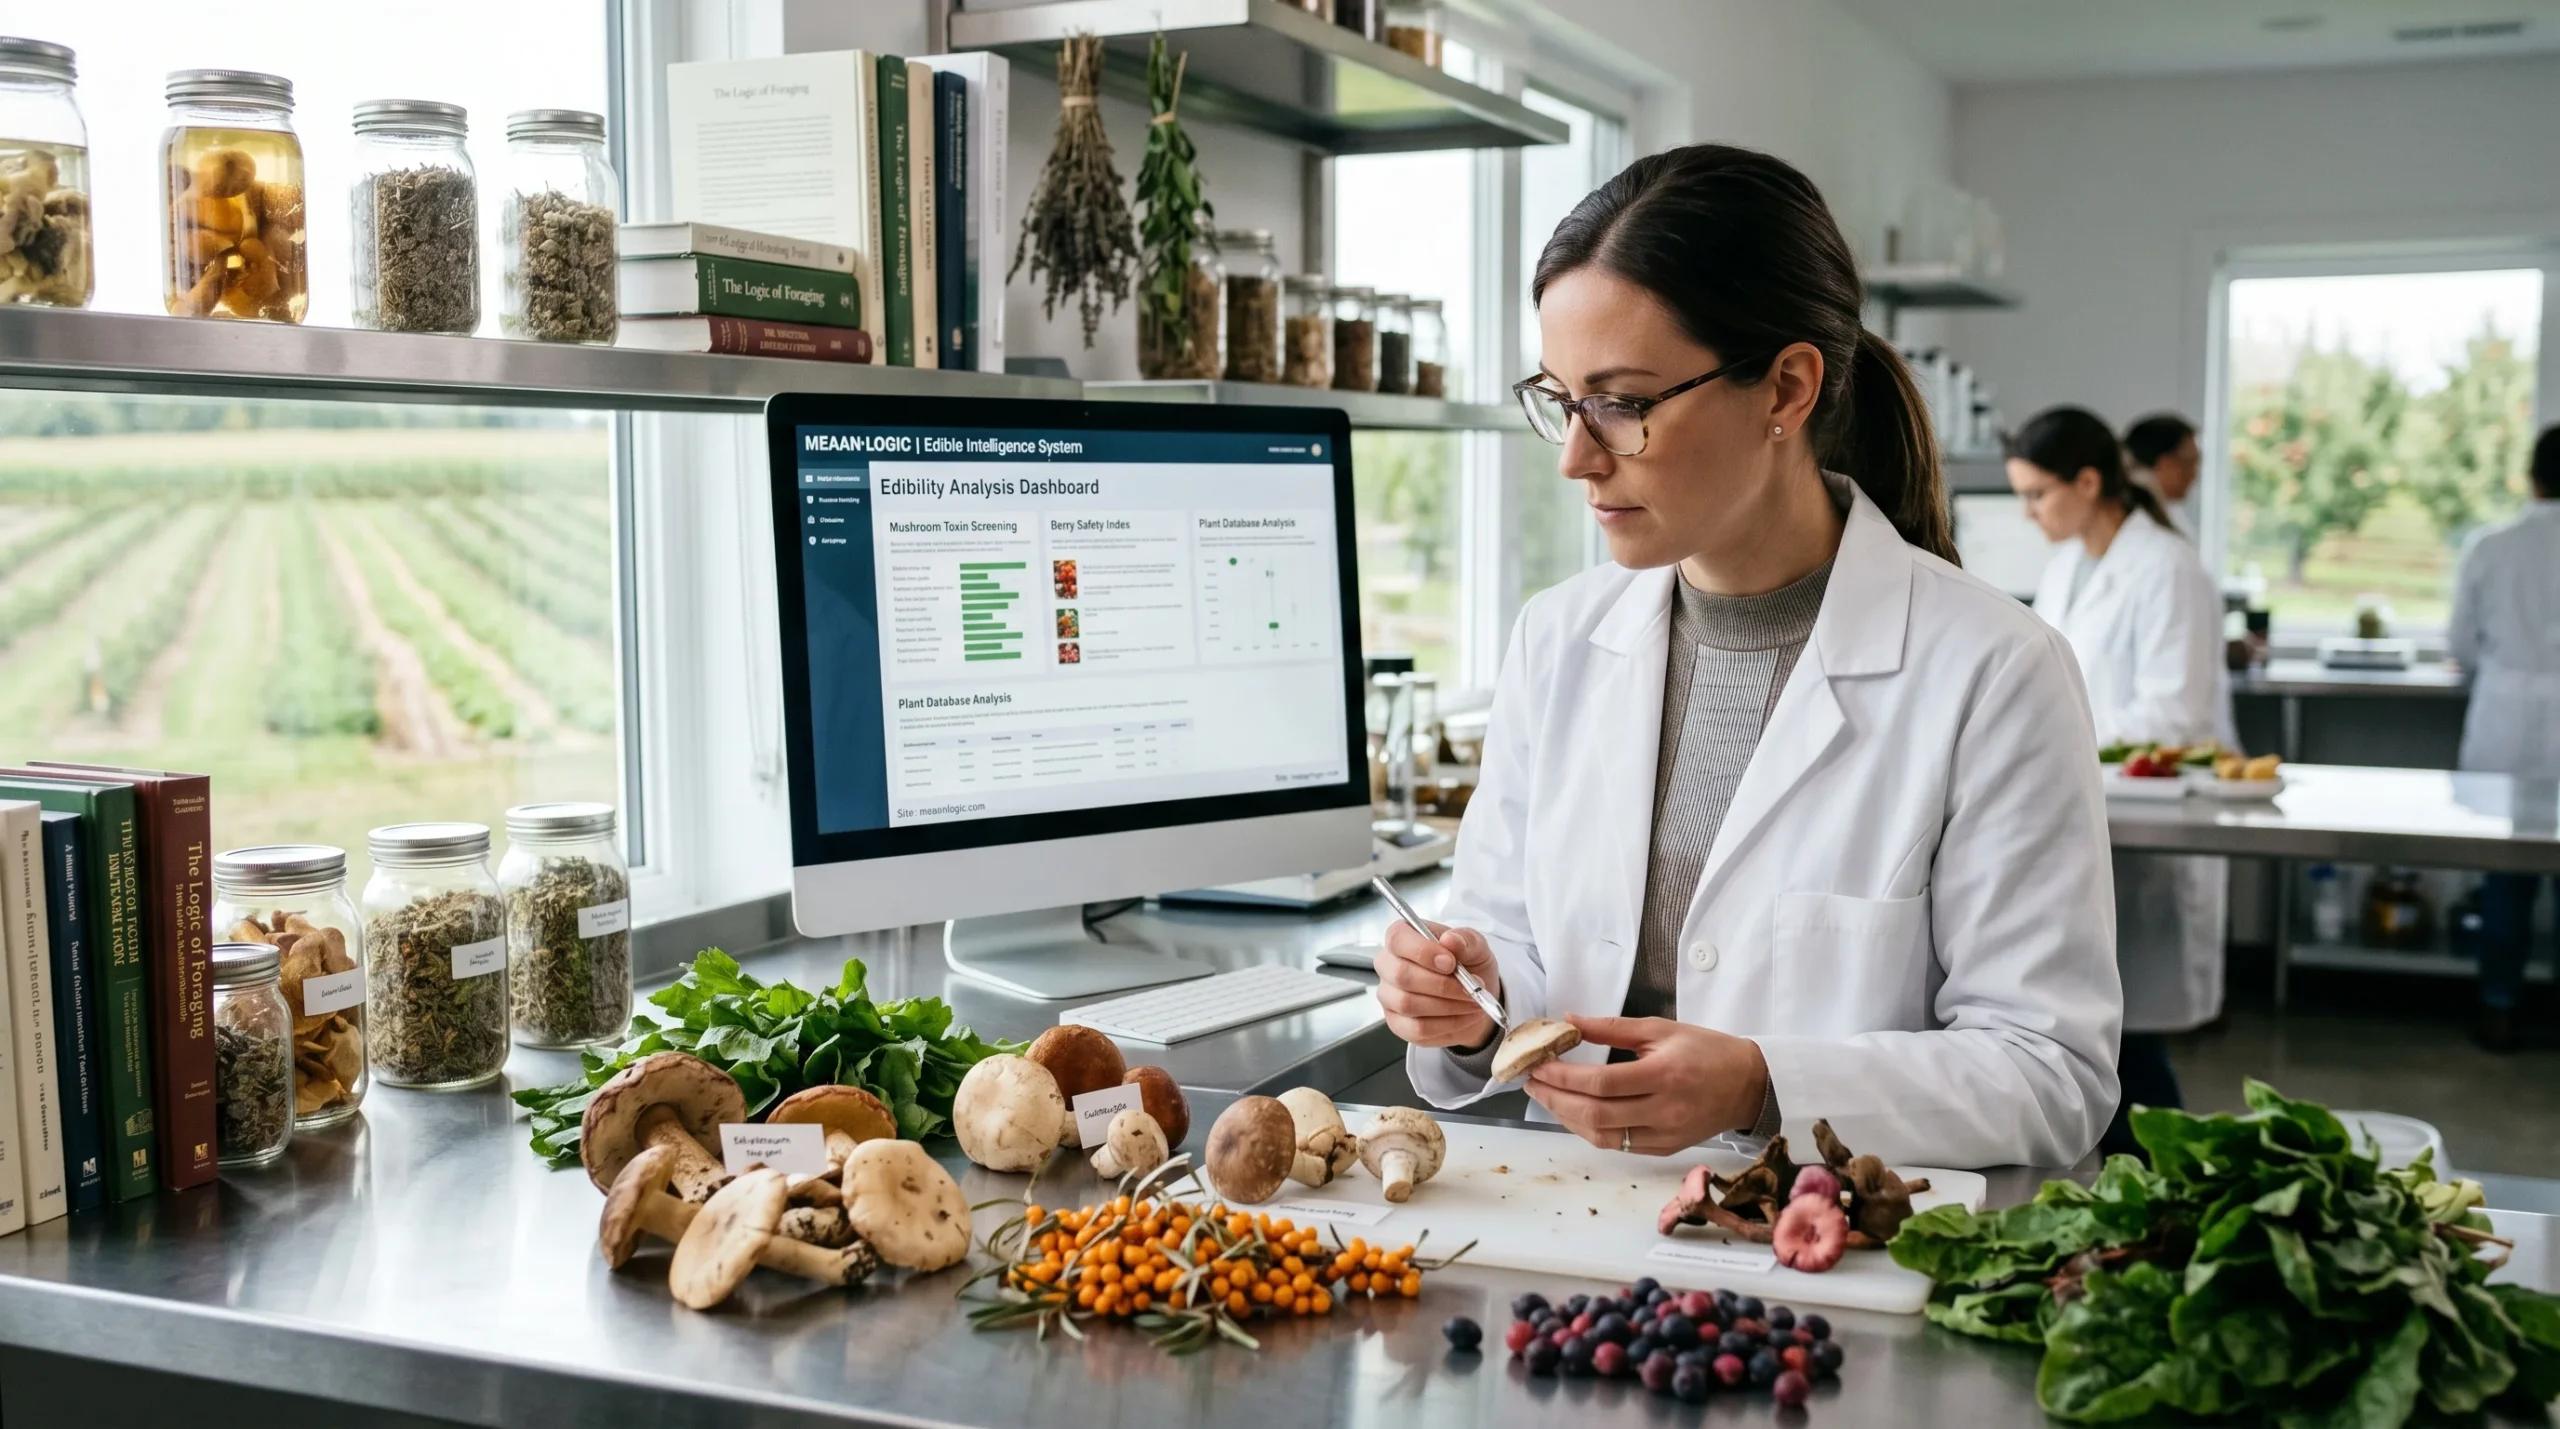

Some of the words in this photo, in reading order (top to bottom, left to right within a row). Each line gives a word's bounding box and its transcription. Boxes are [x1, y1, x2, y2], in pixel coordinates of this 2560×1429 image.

[713, 88, 731, 99] The
[722, 277, 743, 294] The
[744, 280, 771, 301] Logic
[772, 284, 783, 299] of
[784, 285, 825, 308] Foraging
[924, 437, 963, 453] Edible
[966, 438, 1036, 456] Intelligence
[1038, 439, 1083, 457] System
[880, 478, 945, 499] Edibility
[949, 478, 1015, 499] Analysis
[1019, 478, 1100, 495] Dashboard
[889, 521, 942, 533] Mushroom
[943, 521, 969, 532] Toxin
[971, 520, 1018, 534] Screening
[1050, 520, 1075, 533] Berry
[1077, 519, 1104, 532] Safety
[1198, 518, 1221, 528] Plant
[1222, 518, 1260, 528] Database
[1261, 518, 1296, 530] Analysis
[898, 698, 924, 709] Plant
[926, 695, 971, 708] Database
[972, 692, 1012, 706] Analysis
[188, 841, 204, 876] The
[185, 881, 204, 930] Logic
[190, 937, 206, 955] of
[188, 960, 206, 1039] Foraging
